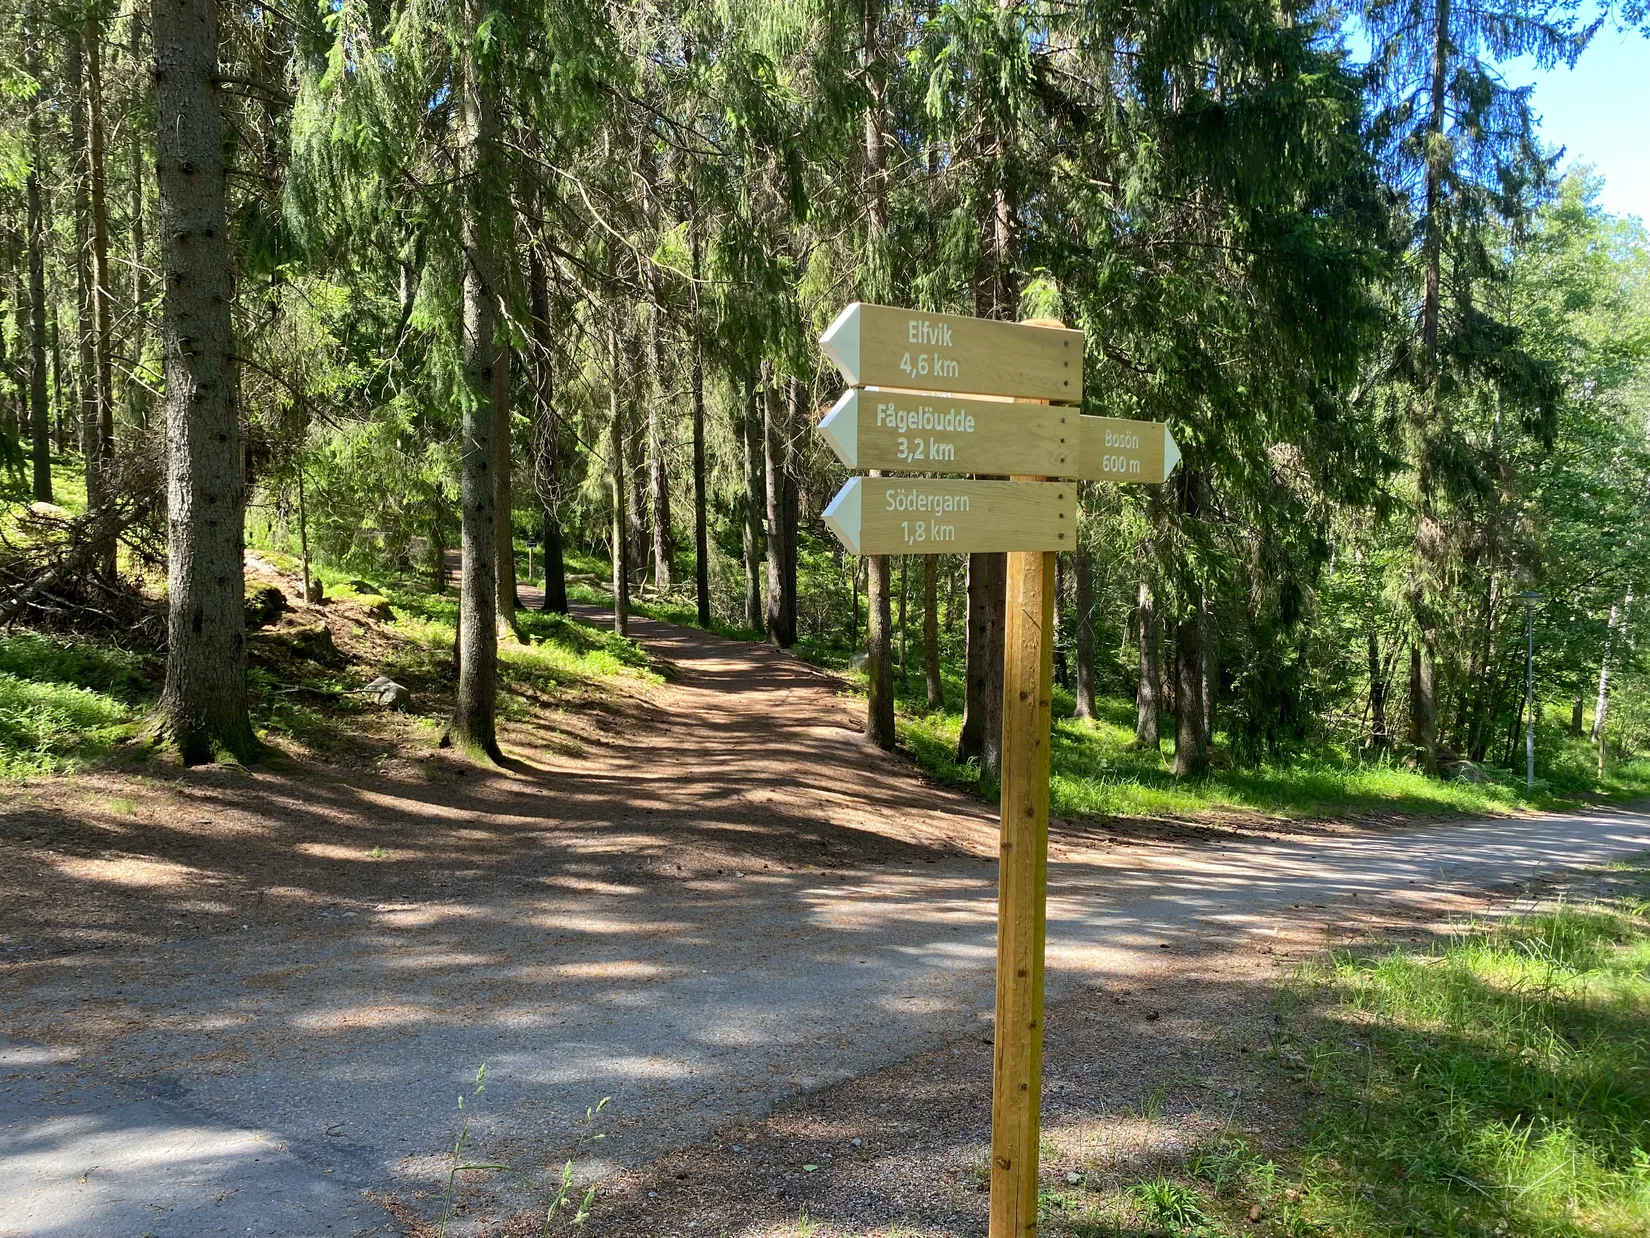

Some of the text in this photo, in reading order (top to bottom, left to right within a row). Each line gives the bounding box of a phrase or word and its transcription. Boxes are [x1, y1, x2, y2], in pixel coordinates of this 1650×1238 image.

[908, 320, 953, 347] Elfvik
[899, 352, 959, 379] 4,6 km
[876, 403, 975, 433] Fågelöudde
[897, 438, 955, 463] 3,2 km
[1104, 429, 1139, 449] Bosön
[1102, 455, 1140, 473] 600 m
[885, 489, 970, 516] Södergarn
[900, 520, 955, 546] 1,8 km
